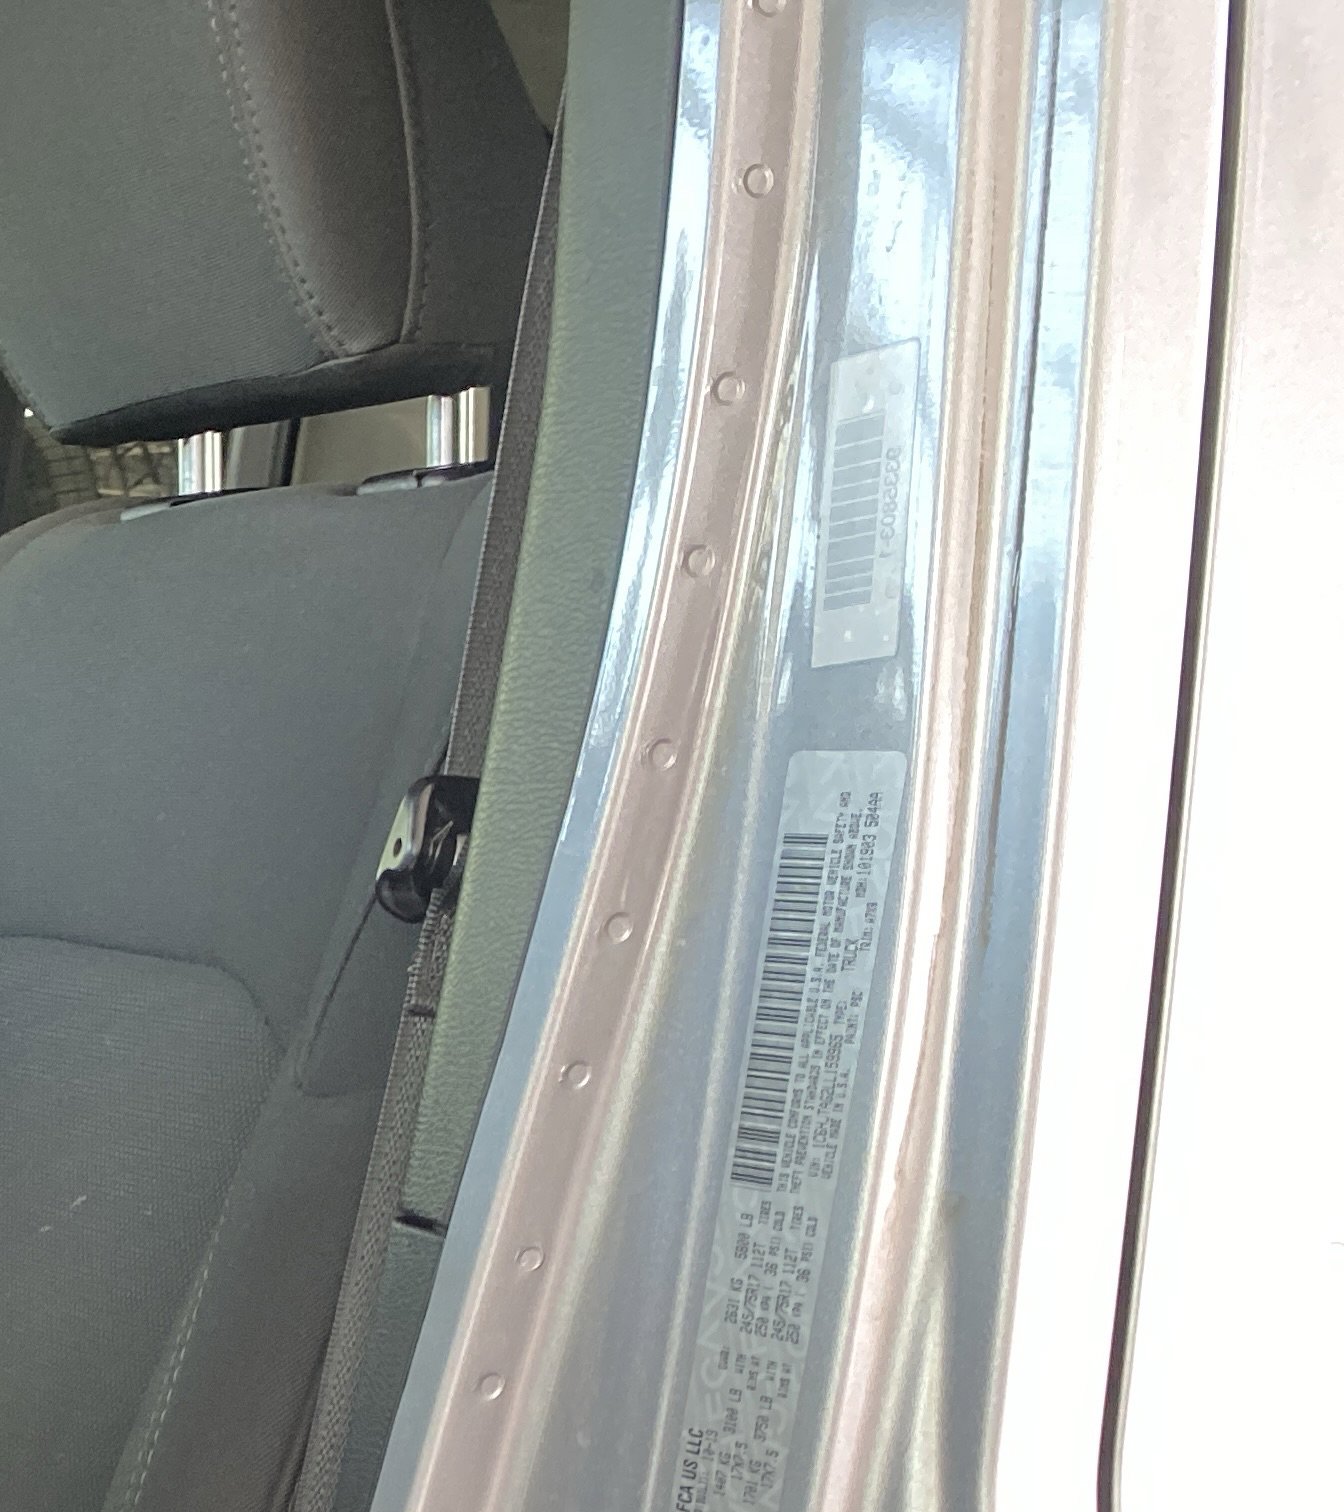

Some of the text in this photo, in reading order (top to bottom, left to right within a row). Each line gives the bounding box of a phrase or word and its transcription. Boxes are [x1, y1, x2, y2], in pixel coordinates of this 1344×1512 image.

[841, 937, 859, 970] TRUCK
[724, 1298, 740, 1323] 2631
[739, 1212, 754, 1226] LB
[727, 1387, 742, 1401] LB
[749, 1241, 767, 1267] 112T
[758, 1394, 773, 1408] LB
[780, 1247, 799, 1273] 112T
[685, 1427, 704, 1454] LLC
[681, 1460, 699, 1478] US
[675, 1485, 695, 1512] FCA
